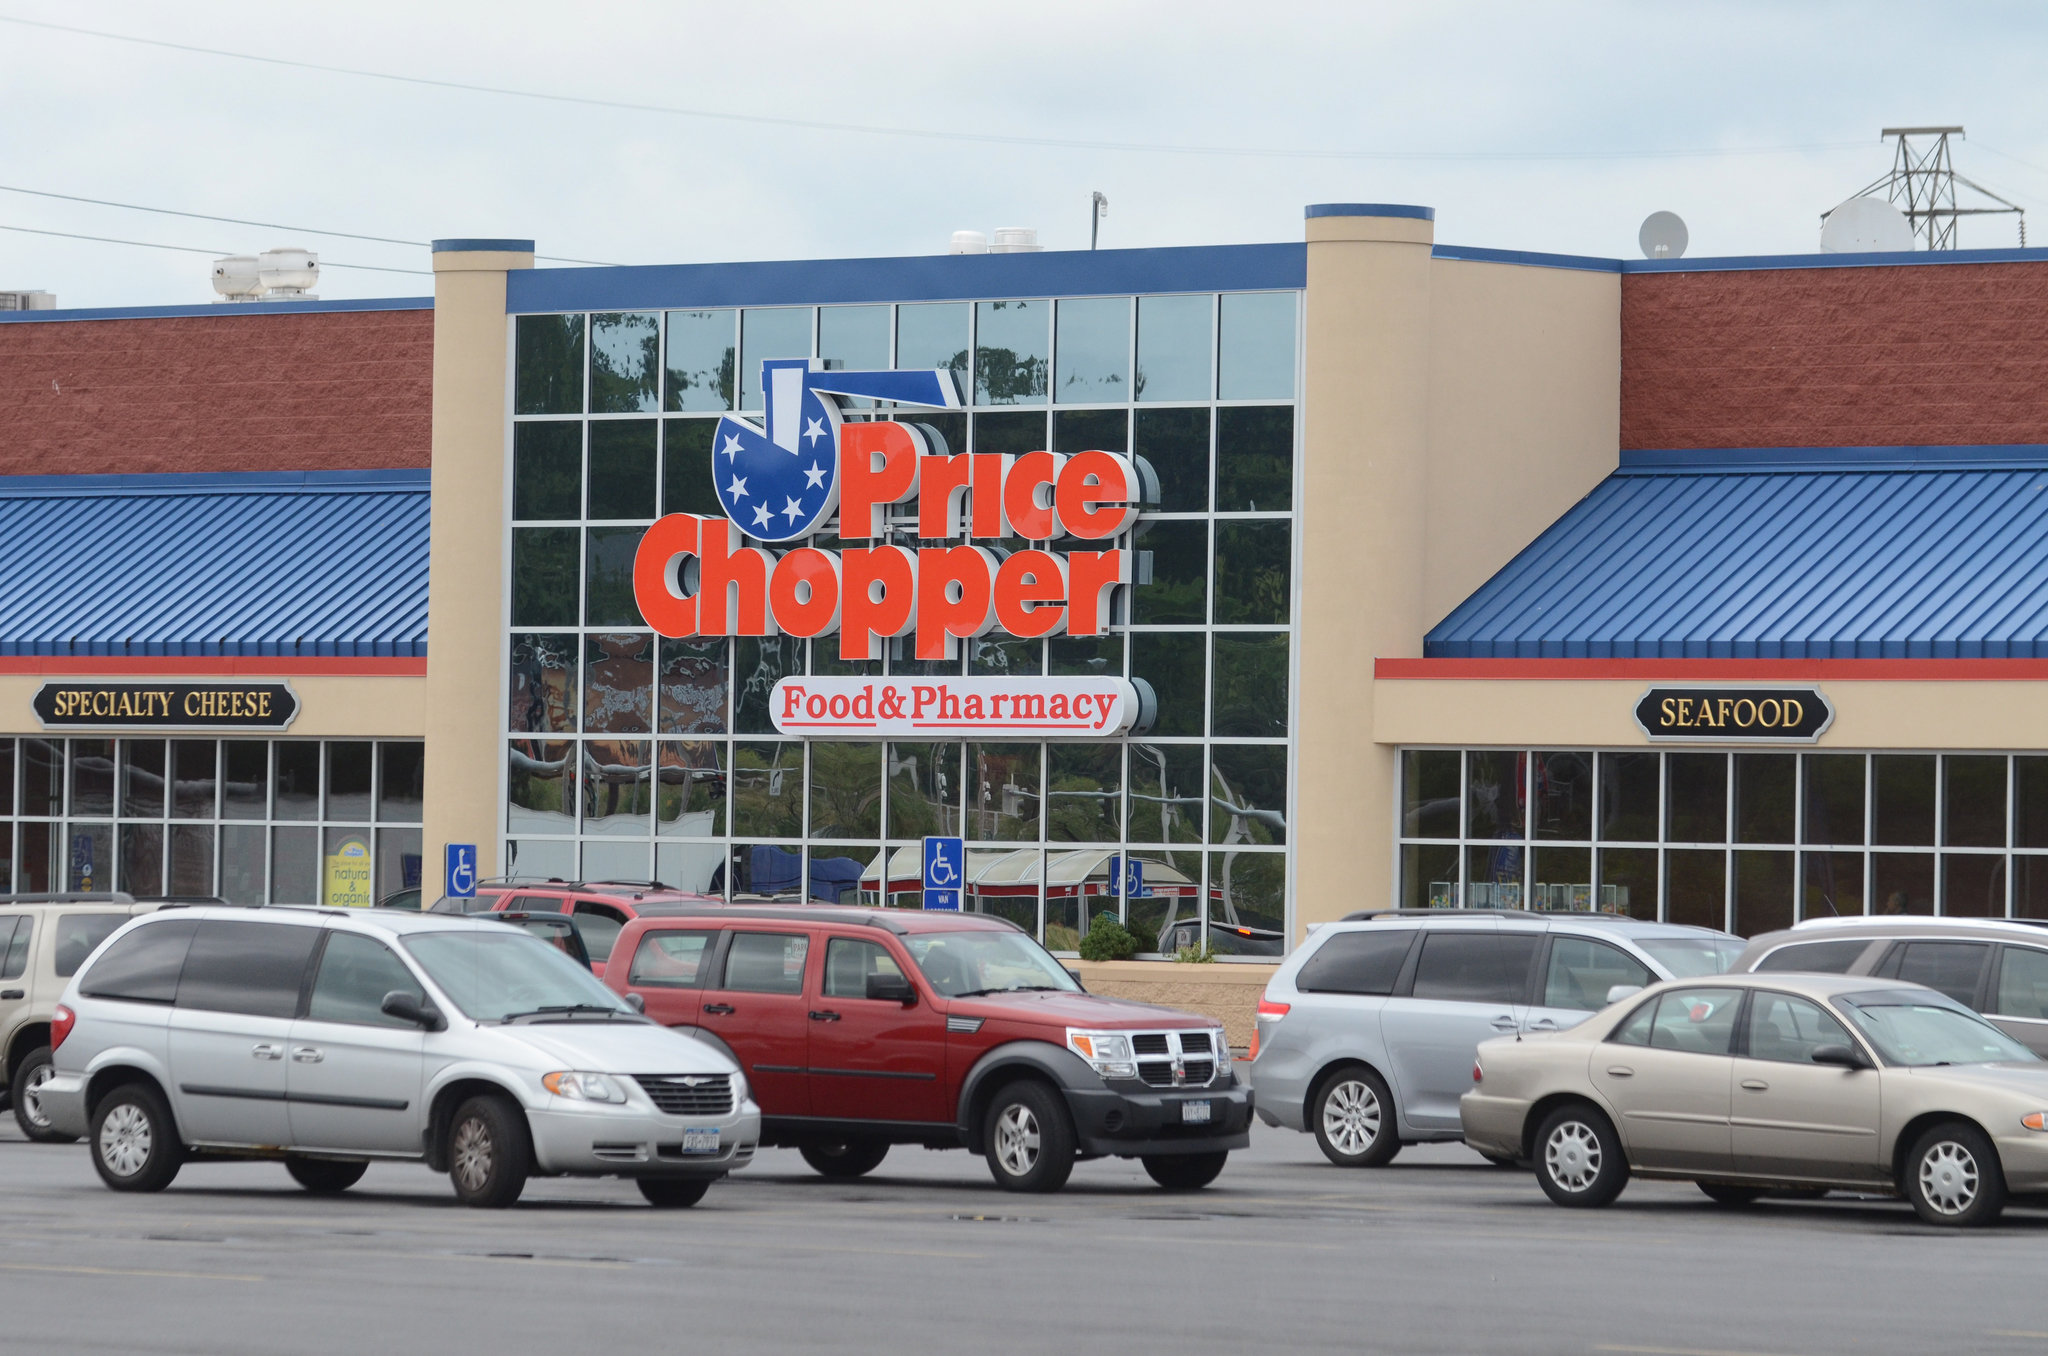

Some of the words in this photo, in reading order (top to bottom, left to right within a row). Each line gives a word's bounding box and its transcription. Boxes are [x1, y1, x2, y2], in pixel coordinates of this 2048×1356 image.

[839, 420, 1130, 540] Price
[633, 512, 1124, 661] Chopper
[54, 691, 174, 717] SPECIALTY
[184, 691, 272, 718] CHEESE
[781, 685, 1117, 730] Food&Pharmacy
[1660, 697, 1804, 728] SEAFOOD
[349, 881, 356, 892] &
[937, 895, 949, 904] VAN
